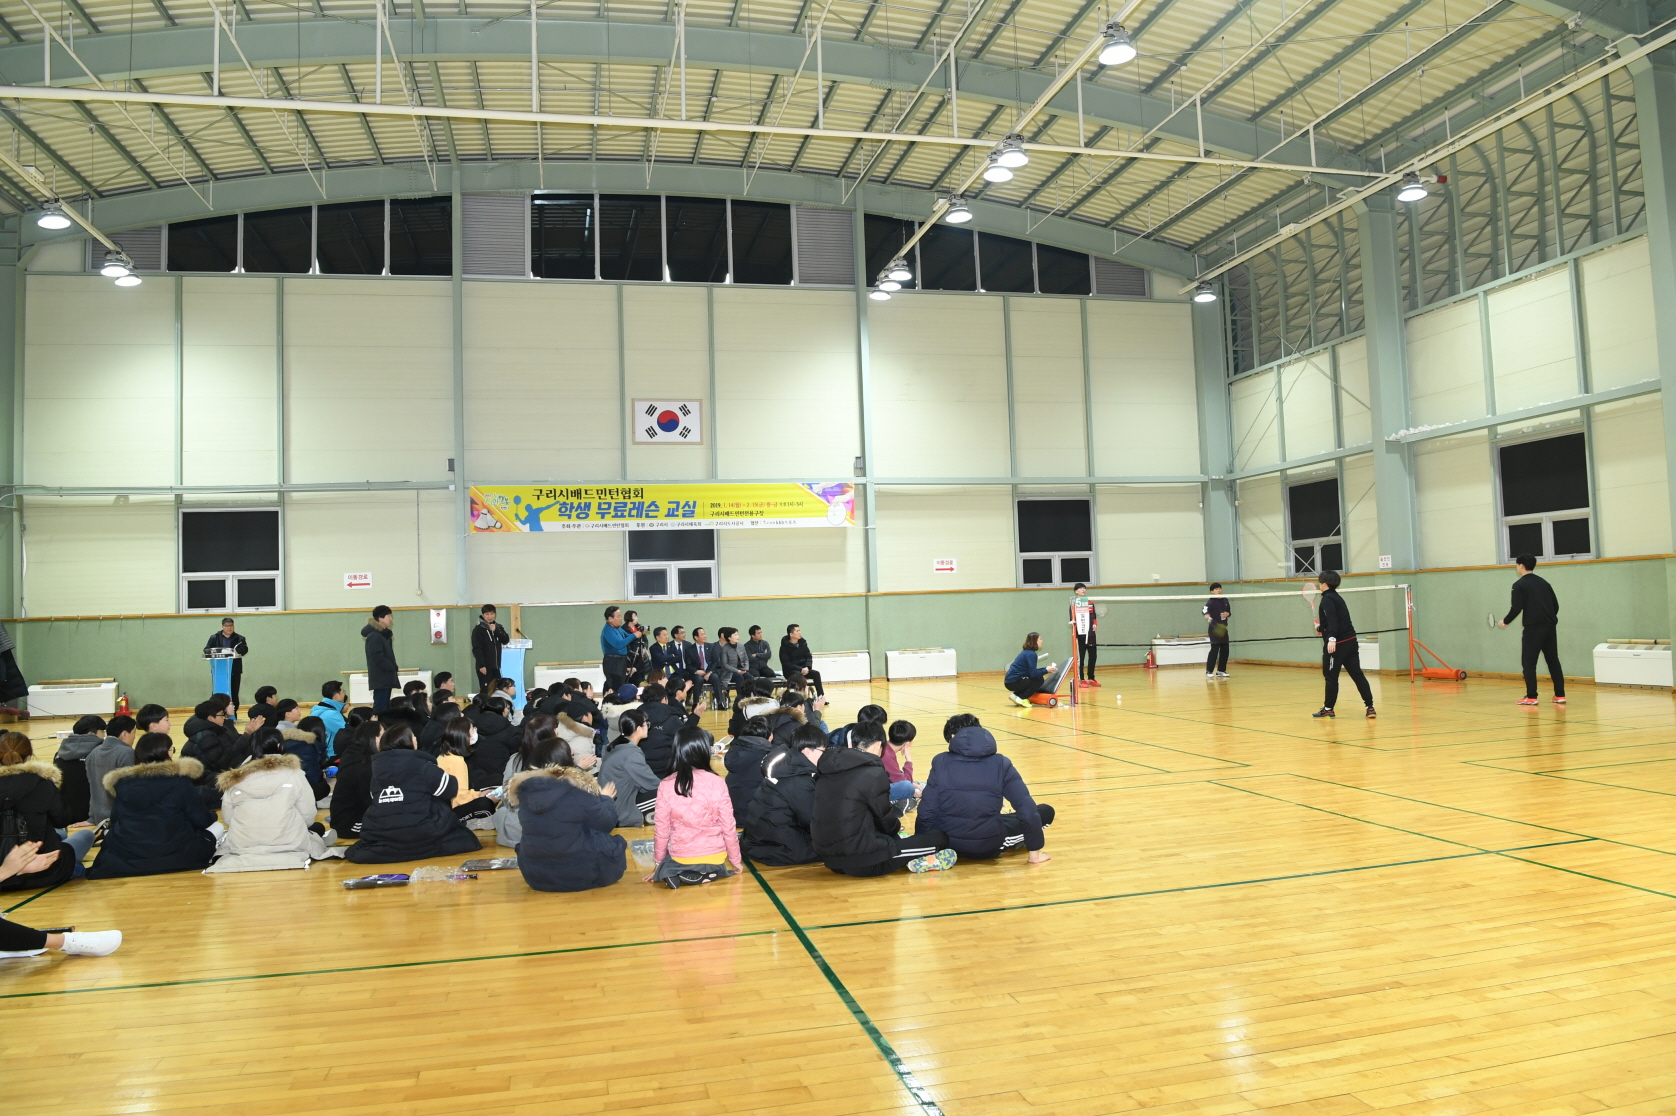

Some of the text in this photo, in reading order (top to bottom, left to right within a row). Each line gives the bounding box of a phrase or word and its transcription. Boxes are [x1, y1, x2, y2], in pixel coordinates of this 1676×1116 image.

[532, 487, 644, 500] 구리시배드민턴협회
[558, 500, 697, 520] 학생 무료레슨 교실
[1075, 597, 1082, 607] 5
